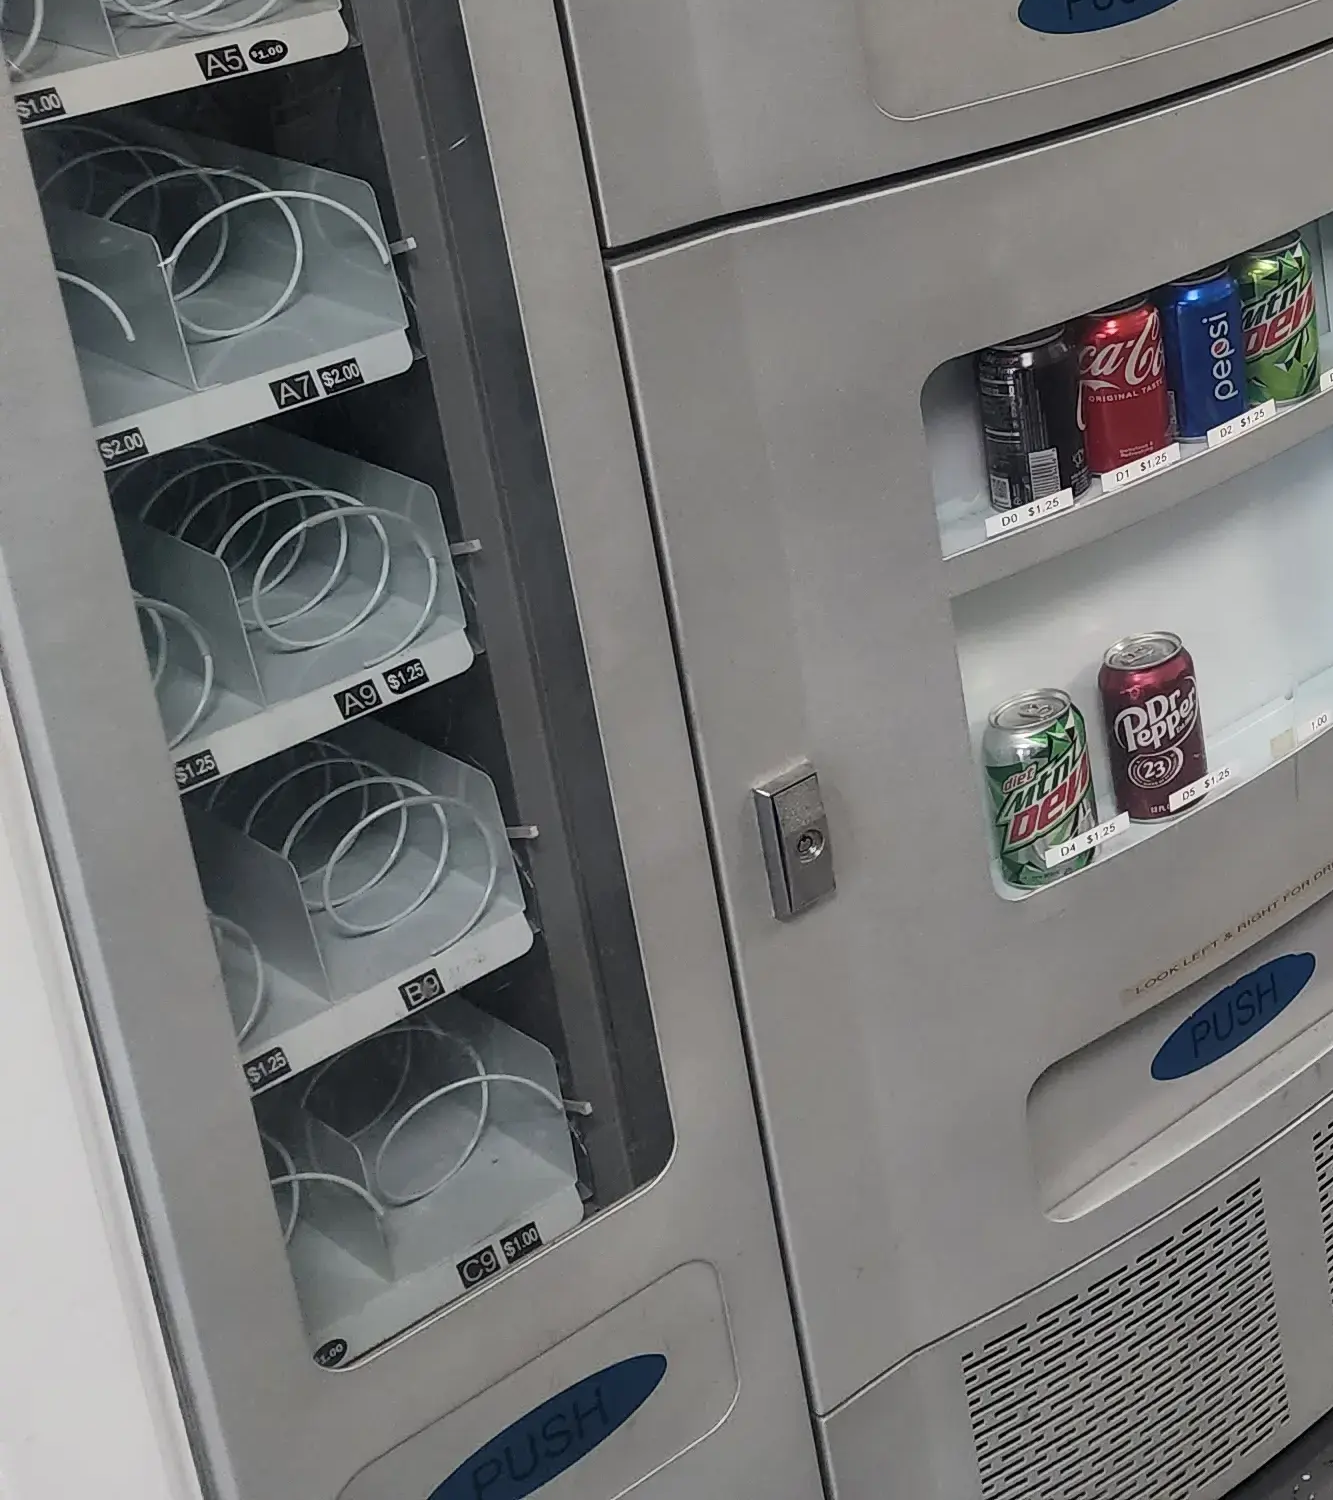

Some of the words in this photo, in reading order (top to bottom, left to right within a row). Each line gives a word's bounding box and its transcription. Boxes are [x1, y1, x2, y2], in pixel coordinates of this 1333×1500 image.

[205, 51, 244, 77] A5
[250, 44, 284, 60] $1.00
[16, 92, 62, 119] $1.00
[1202, 311, 1239, 401] pepsi
[278, 375, 310, 406] A7
[320, 362, 360, 388] $2.00
[1088, 389, 1139, 403] ORIGINAL
[1219, 425, 1233, 439] D2
[1240, 408, 1265, 429] $1.25
[100, 431, 144, 460] $2.00
[1115, 470, 1131, 483] D1
[1140, 451, 1168, 473] $1.25
[1027, 497, 1060, 518] $1.25
[344, 684, 379, 715] A9
[387, 661, 425, 691] $1.25
[1115, 686, 1195, 753] Pepper
[1145, 688, 1181, 725] Dr
[1004, 766, 1035, 792] diet
[1143, 761, 1166, 779] 23
[1182, 787, 1196, 801] D5
[1204, 766, 1231, 789] $1.25
[1060, 842, 1076, 858] D4
[1086, 822, 1116, 844] $1.25
[1135, 963, 1180, 995] LOOK
[1183, 937, 1218, 967] LEFT
[1223, 931, 1233, 942] &
[1237, 899, 1280, 933] RIGHT
[1282, 878, 1311, 903] FOR
[403, 973, 440, 1004] B9
[1190, 971, 1279, 1059] PUSH
[247, 1051, 287, 1084] $1.25
[462, 1250, 497, 1283] C9
[502, 1227, 539, 1258] $1.00
[472, 1385, 609, 1500] PUSH
